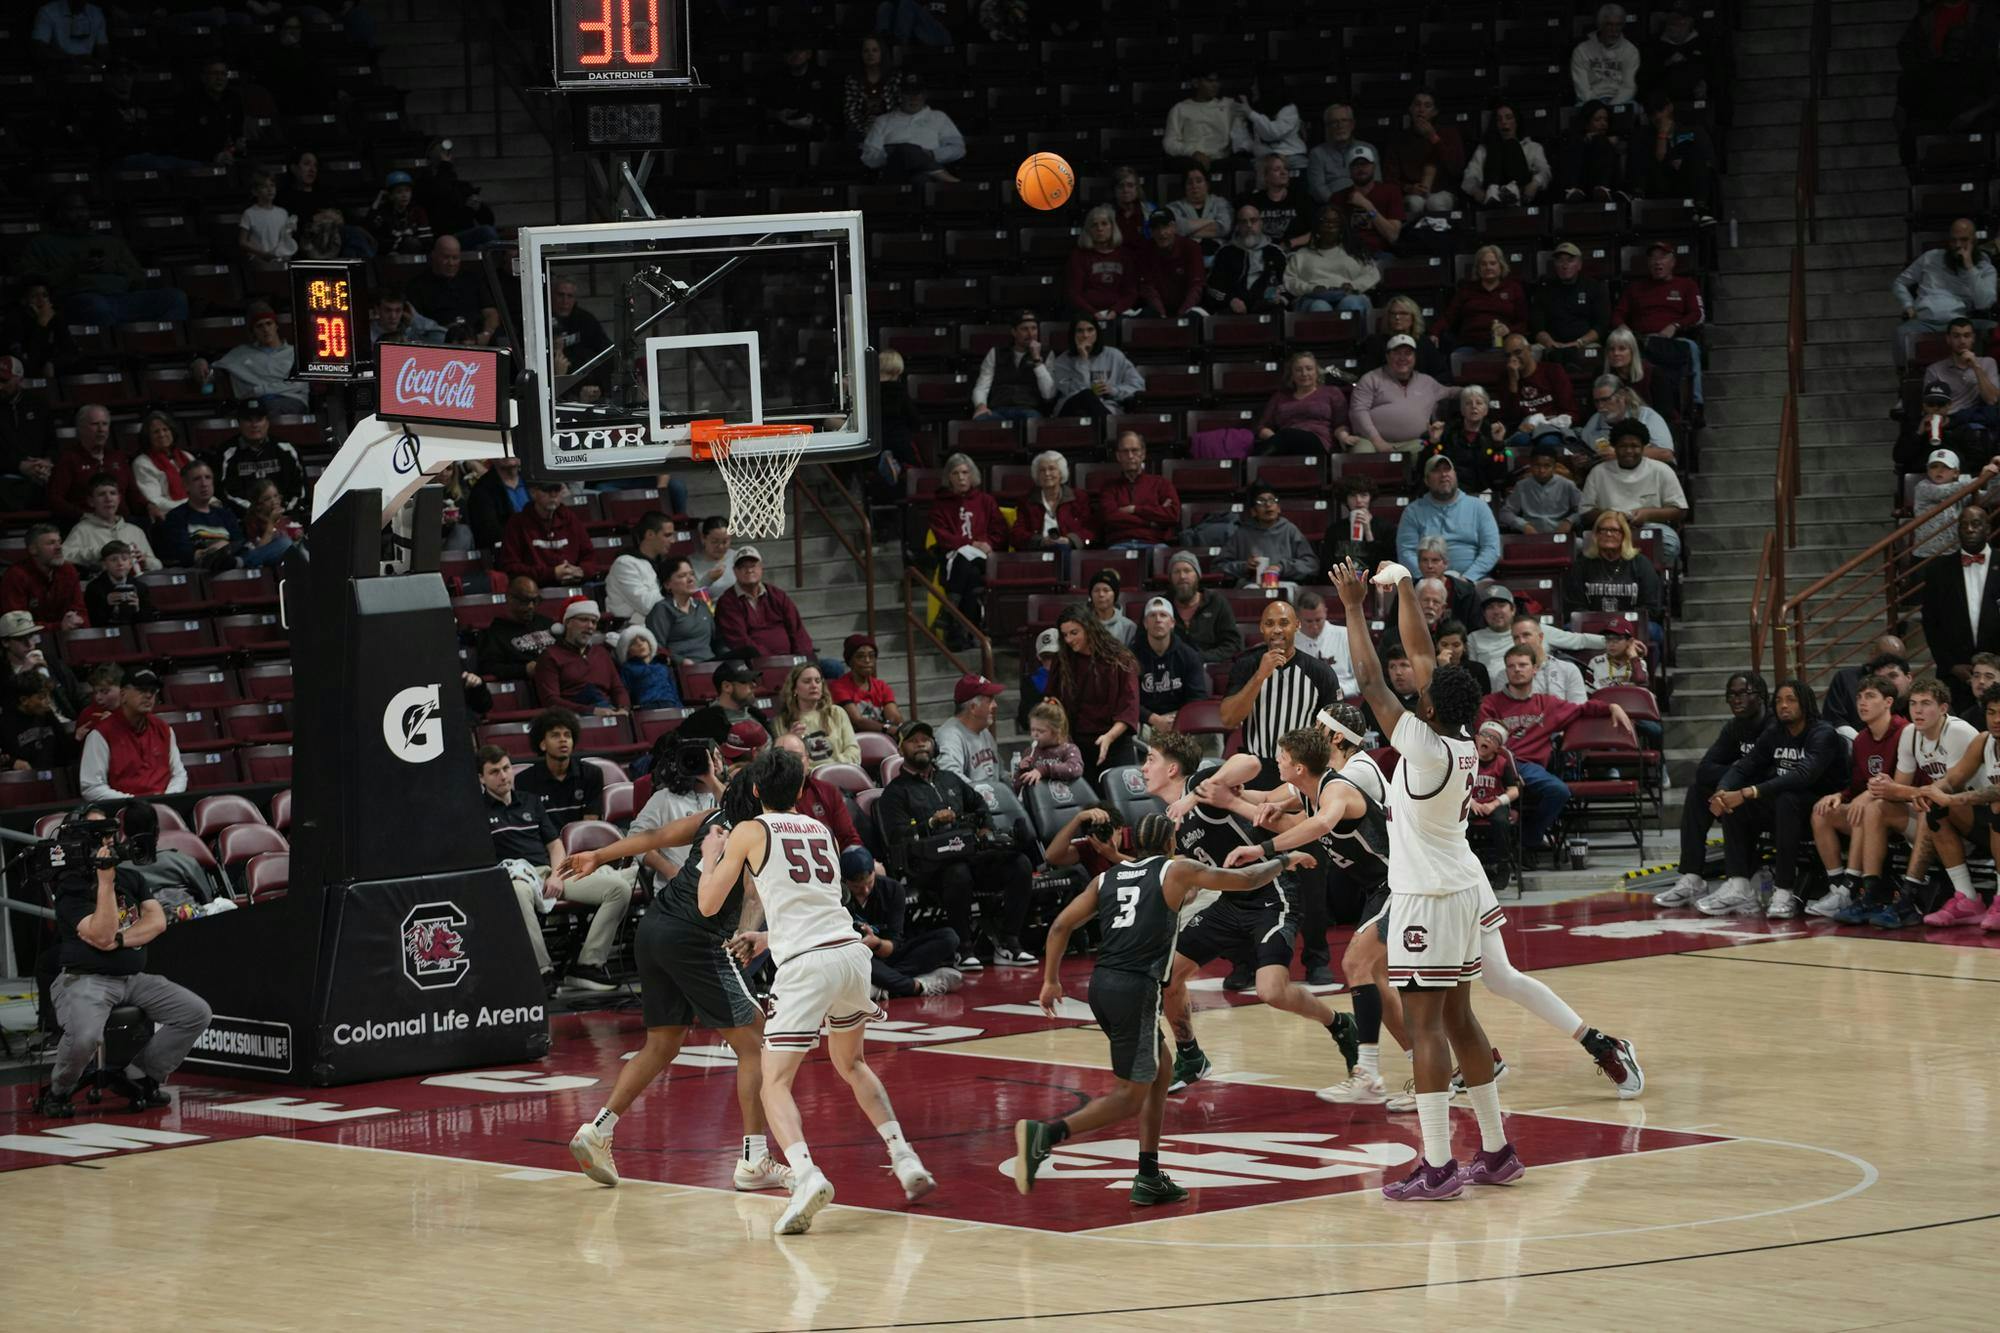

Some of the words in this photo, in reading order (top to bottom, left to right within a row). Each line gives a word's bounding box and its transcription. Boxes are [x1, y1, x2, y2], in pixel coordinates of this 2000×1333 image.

[579, 0, 659, 64] 30
[588, 71, 655, 80] DAKTRONICS
[317, 317, 347, 357] 30
[308, 364, 350, 373] DAKTRONICS
[395, 357, 480, 410] Coca-Cola
[555, 454, 588, 465] SPALDING
[782, 838, 834, 884] 55
[1111, 885, 1141, 929] 3
[333, 1012, 427, 1046] Colonial
[433, 1008, 470, 1033] Life
[477, 1003, 544, 1028] Arena
